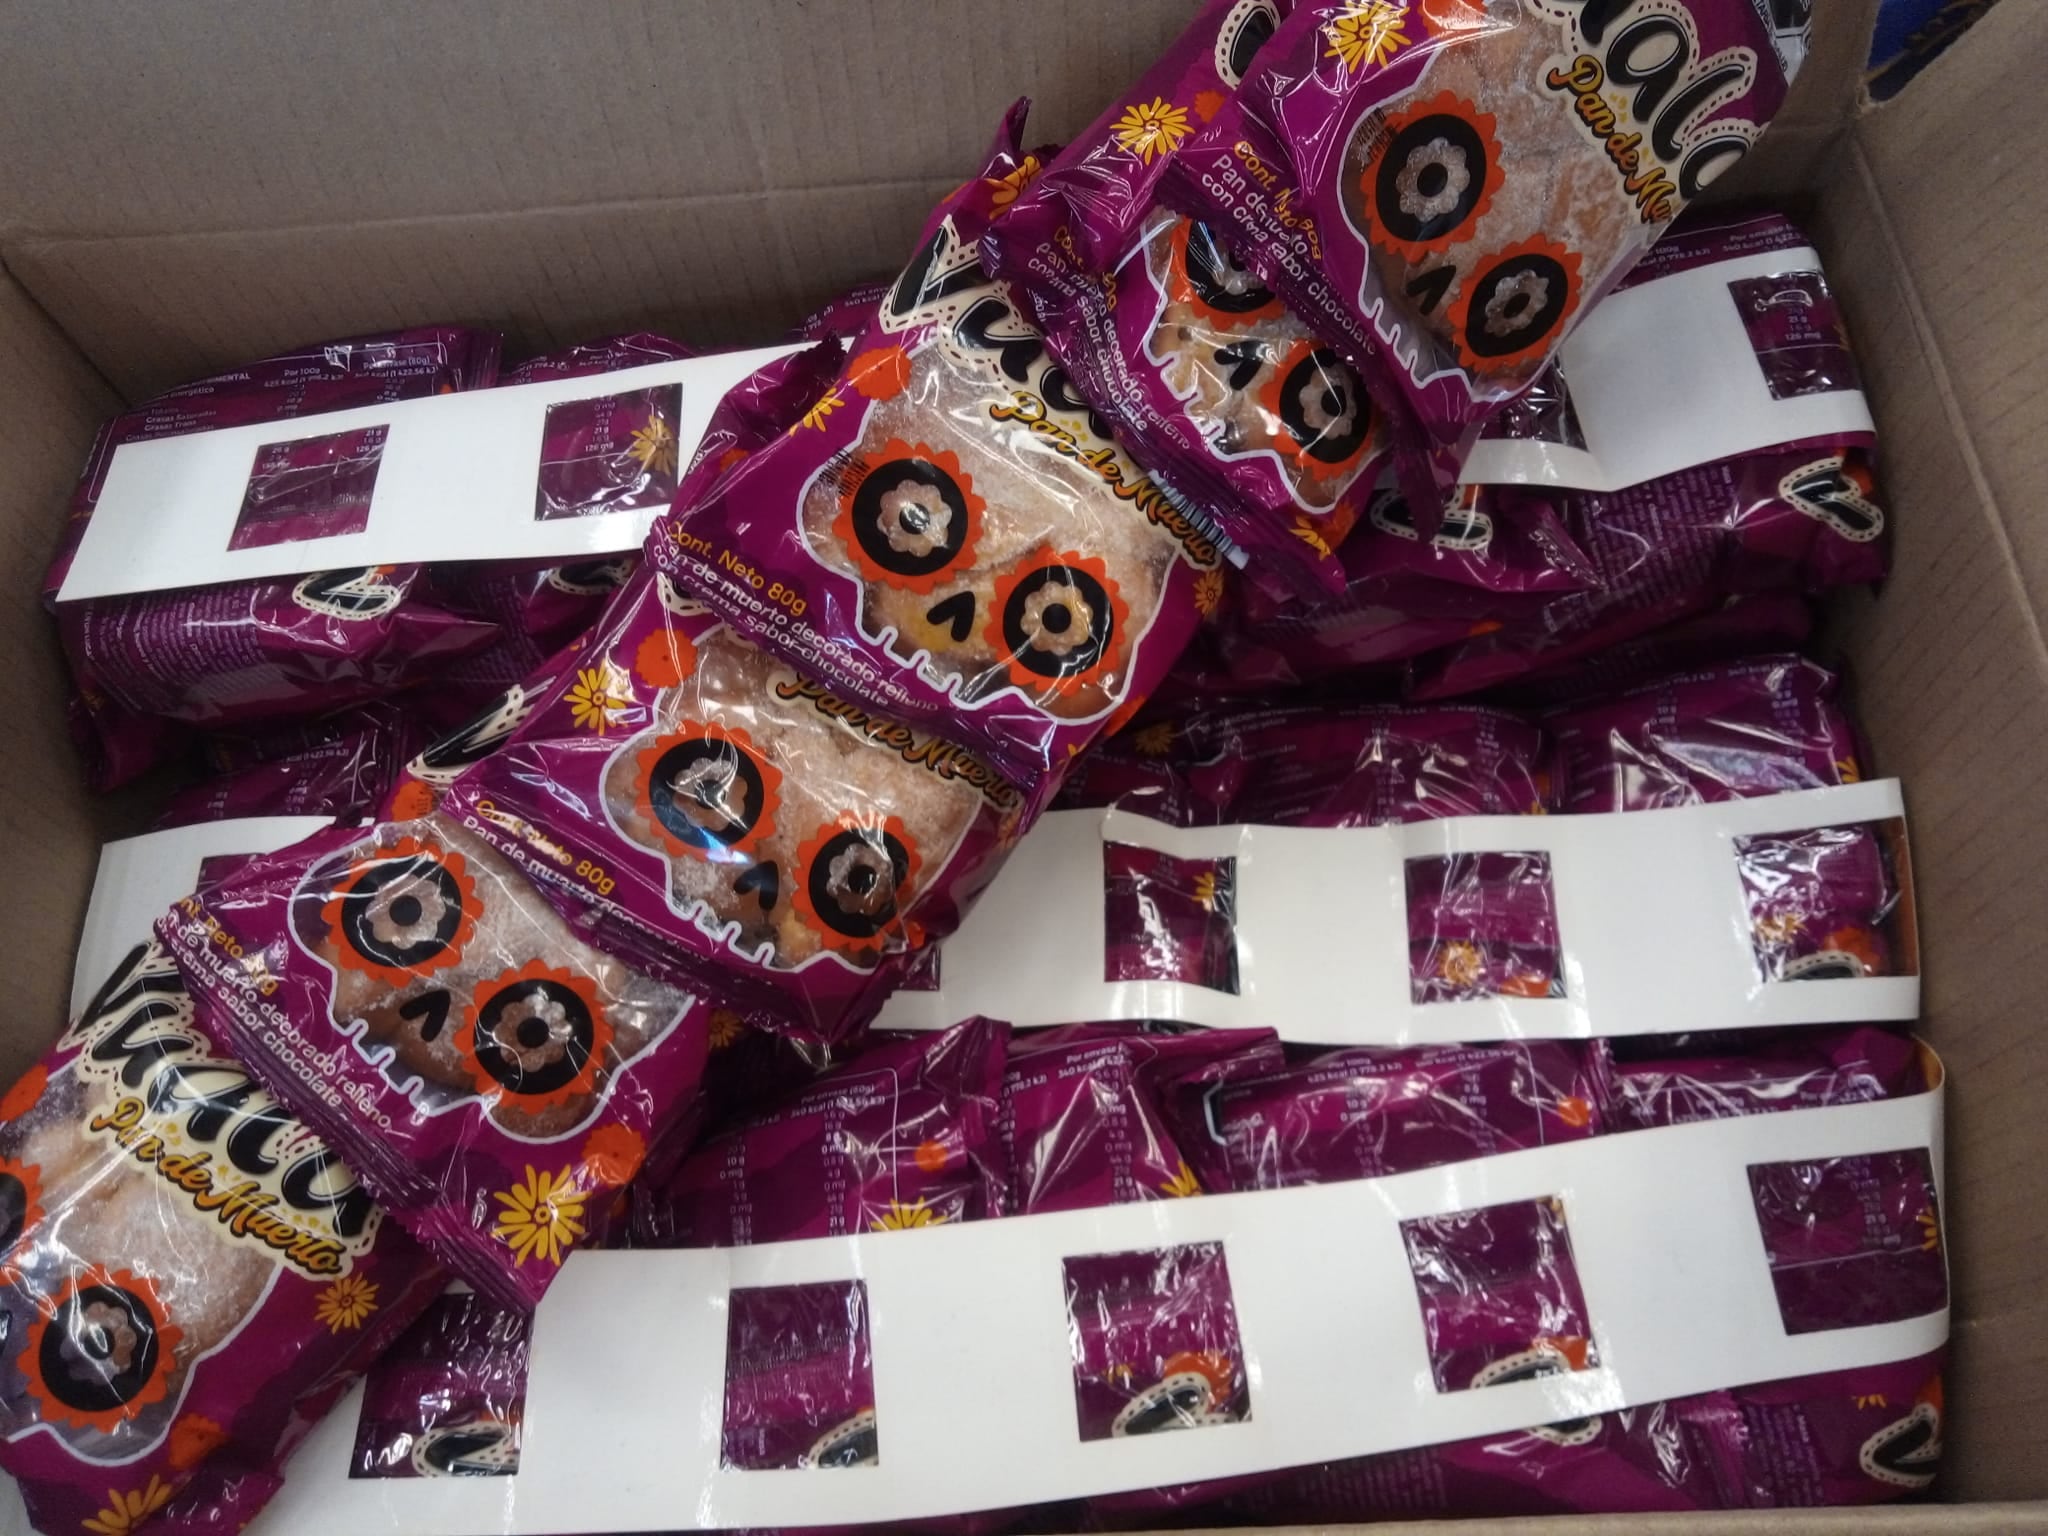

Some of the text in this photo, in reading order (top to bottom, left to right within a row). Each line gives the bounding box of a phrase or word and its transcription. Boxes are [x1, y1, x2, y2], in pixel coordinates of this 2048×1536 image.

[1545, 54, 1616, 138] Pan
[1605, 132, 1643, 174] de
[1212, 155, 1247, 194] Pan
[1234, 141, 1278, 191] Cont.
[1202, 173, 1234, 208] con
[1308, 281, 1376, 355] chocolate
[1076, 296, 1101, 345] sabor
[989, 390, 1222, 567] Pan de Muerto
[653, 544, 680, 576] con
[746, 615, 798, 650] sabor
[800, 647, 890, 707] chocolate
[717, 549, 765, 591] Neto
[767, 583, 807, 617] 80g
[692, 562, 718, 585] de
[720, 582, 788, 627] muerto
[792, 621, 876, 683] decorado
[877, 673, 940, 713] relleno
[864, 717, 912, 748] de
[902, 736, 1019, 809] Muerto
[464, 815, 498, 845] Pan
[500, 841, 526, 862] de
[575, 860, 616, 895] 80g
[217, 984, 265, 1032] sabor
[263, 1031, 343, 1108] chocolate
[260, 1000, 337, 1078] decorado
[90, 1096, 348, 1275] Pan de Muerto
